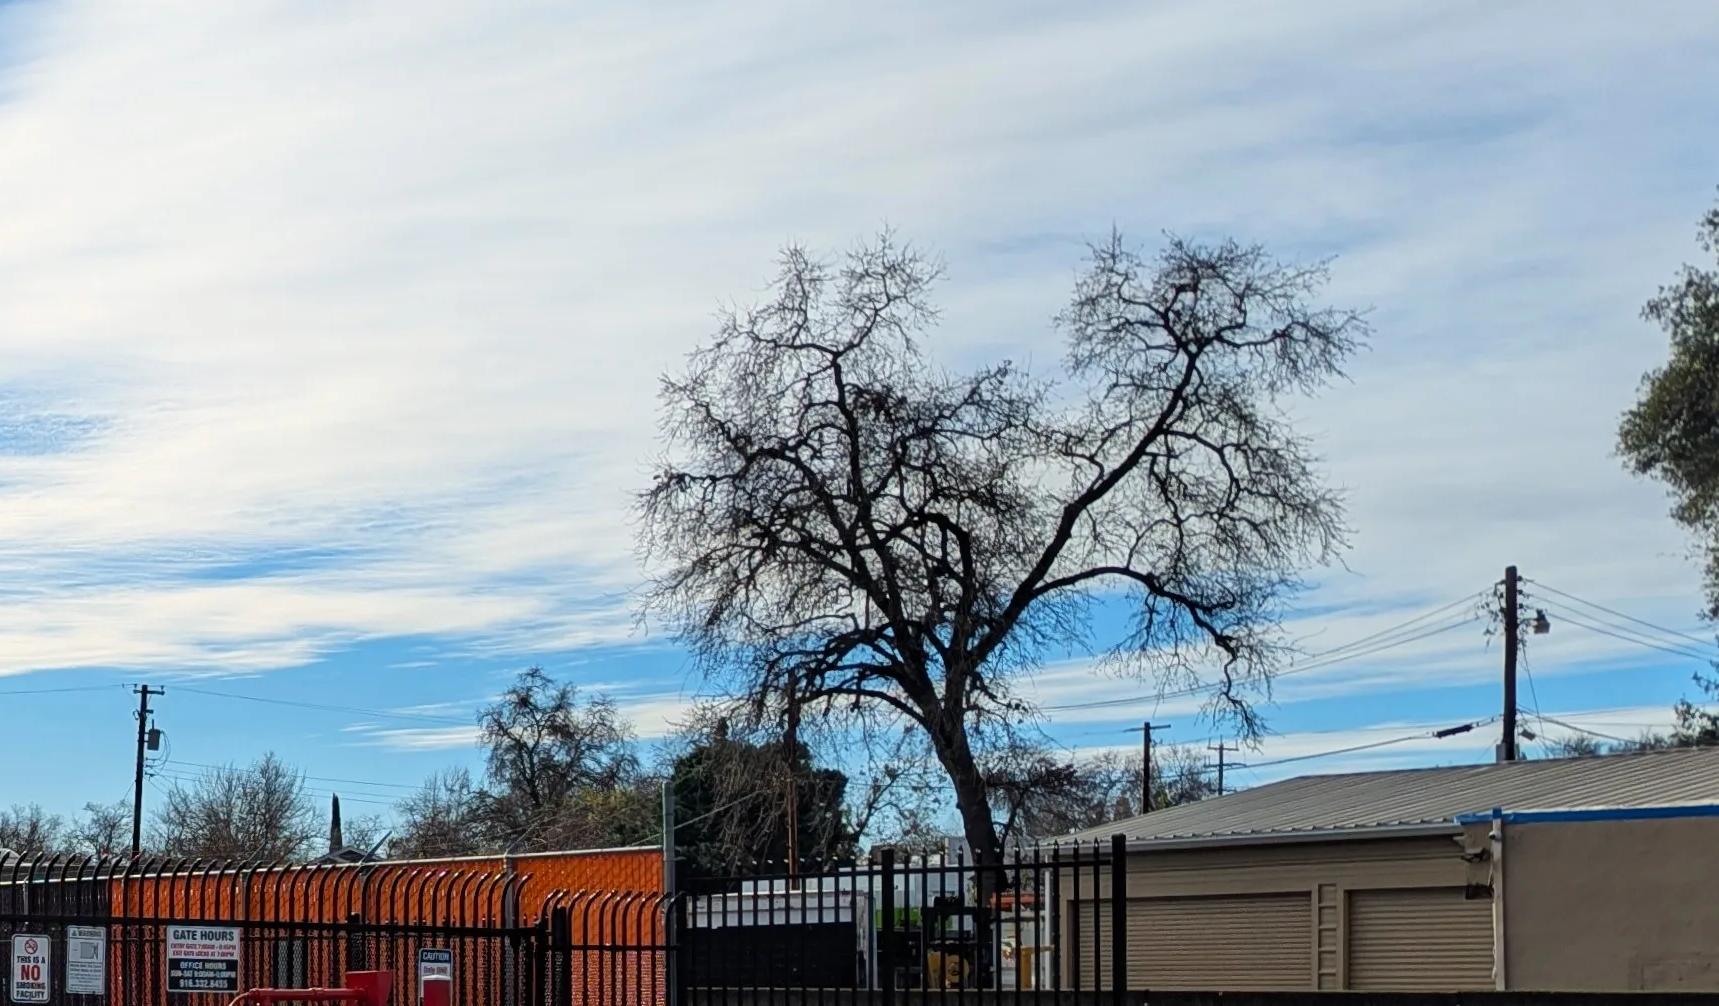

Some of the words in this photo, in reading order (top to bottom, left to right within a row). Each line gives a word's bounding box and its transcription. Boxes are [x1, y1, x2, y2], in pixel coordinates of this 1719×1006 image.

[173, 929, 198, 941] GATE
[200, 930, 235, 942] HOURS
[16, 955, 32, 964] THIS
[33, 955, 40, 964] IS
[41, 956, 46, 964] A
[422, 951, 450, 961] CAUTION
[179, 961, 203, 969] OFFICE
[204, 962, 227, 970] HOURS
[20, 964, 41, 981] NO
[16, 982, 46, 990] SMOKING
[16, 991, 45, 999] FACILITY
